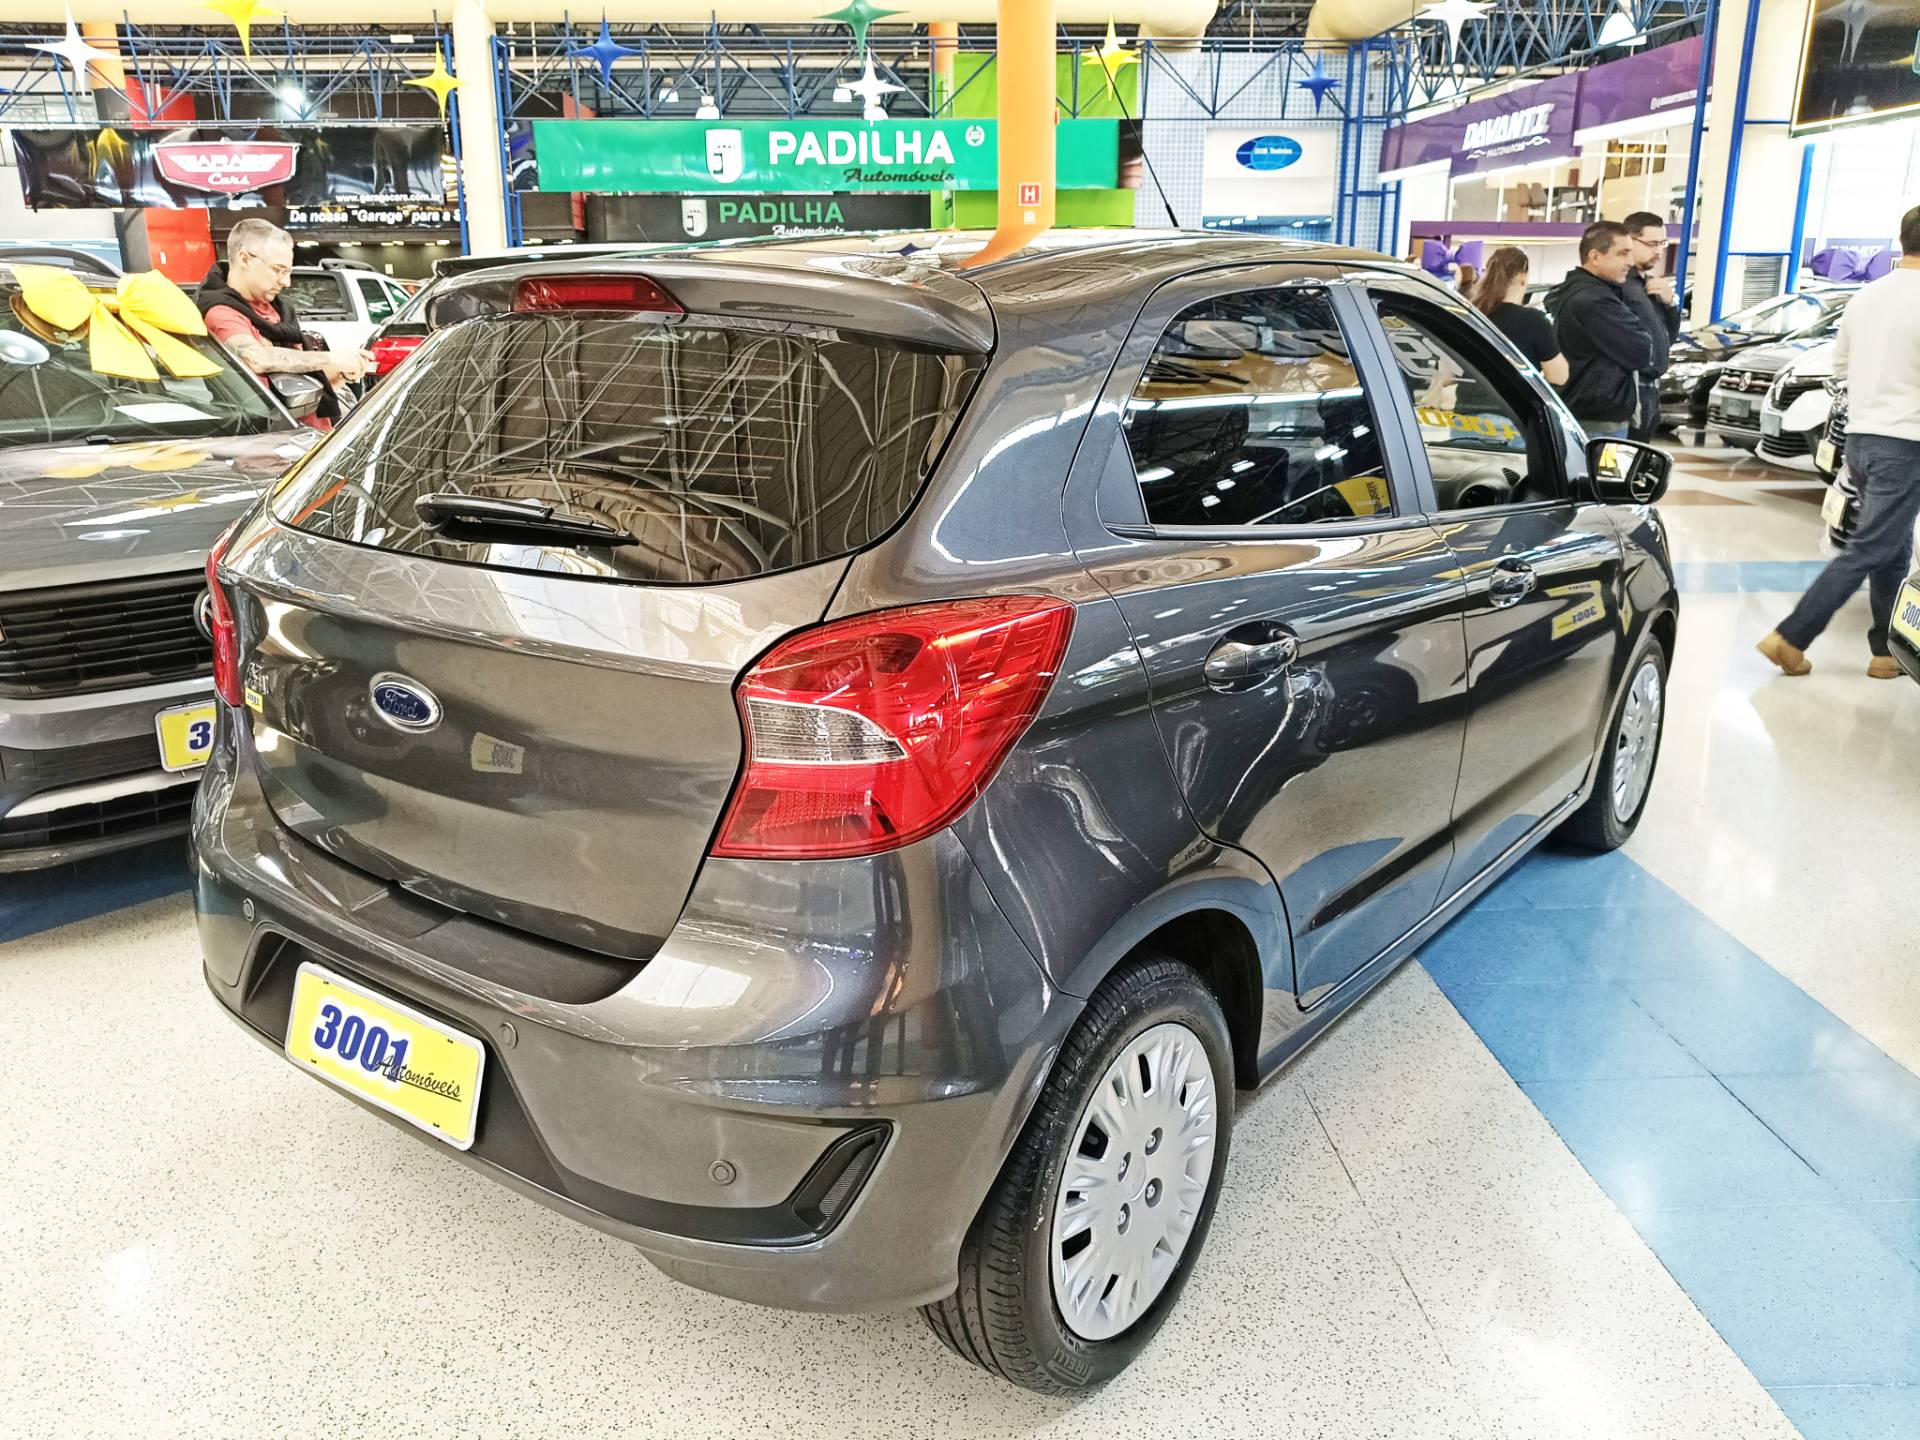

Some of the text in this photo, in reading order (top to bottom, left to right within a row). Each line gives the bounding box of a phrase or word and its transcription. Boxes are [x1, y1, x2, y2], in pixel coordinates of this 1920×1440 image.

[1462, 103, 1556, 151] DAVANTI
[768, 130, 956, 166] PADILHA
[207, 172, 250, 186] Cars
[843, 168, 955, 183] Automóveis
[1023, 186, 1037, 203] H
[289, 210, 307, 222] Da
[411, 211, 440, 224] para
[442, 211, 451, 222] a
[719, 201, 844, 224] PADILHA
[382, 689, 419, 719] Ford
[189, 721, 216, 750] 3
[314, 1003, 410, 1082] 3001
[374, 1054, 462, 1098] Automóveis
